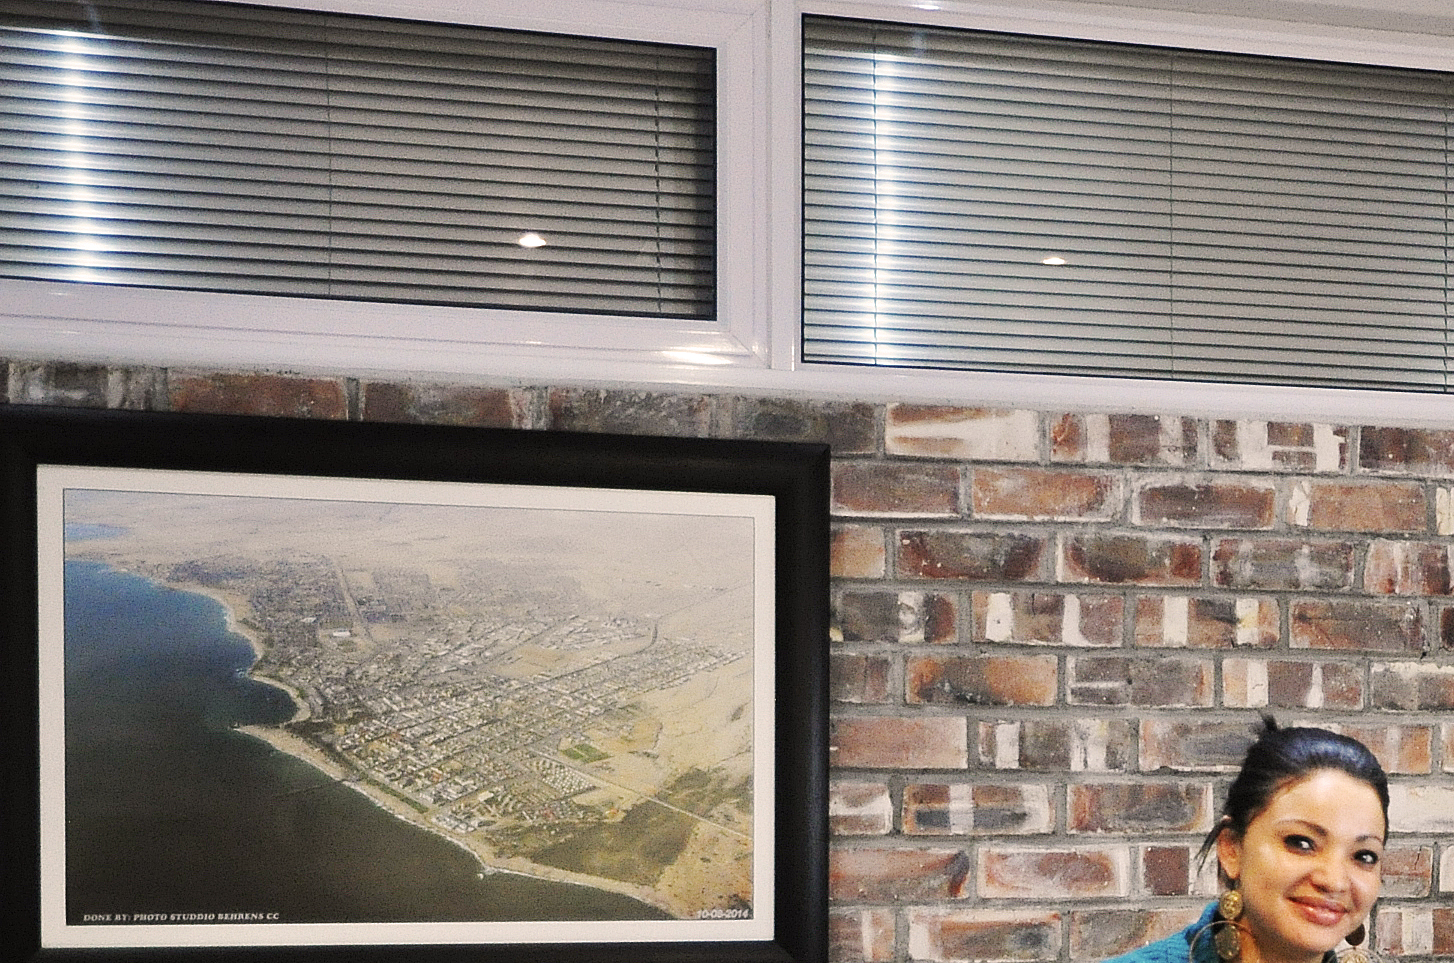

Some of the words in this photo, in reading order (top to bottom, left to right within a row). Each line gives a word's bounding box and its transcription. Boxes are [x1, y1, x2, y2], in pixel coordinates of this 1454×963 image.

[83, 913, 113, 921] DONE
[133, 913, 168, 921] PHOTO
[169, 912, 215, 921] STUDDIO
[217, 912, 265, 921] BEHRENS
[266, 912, 280, 920] CC
